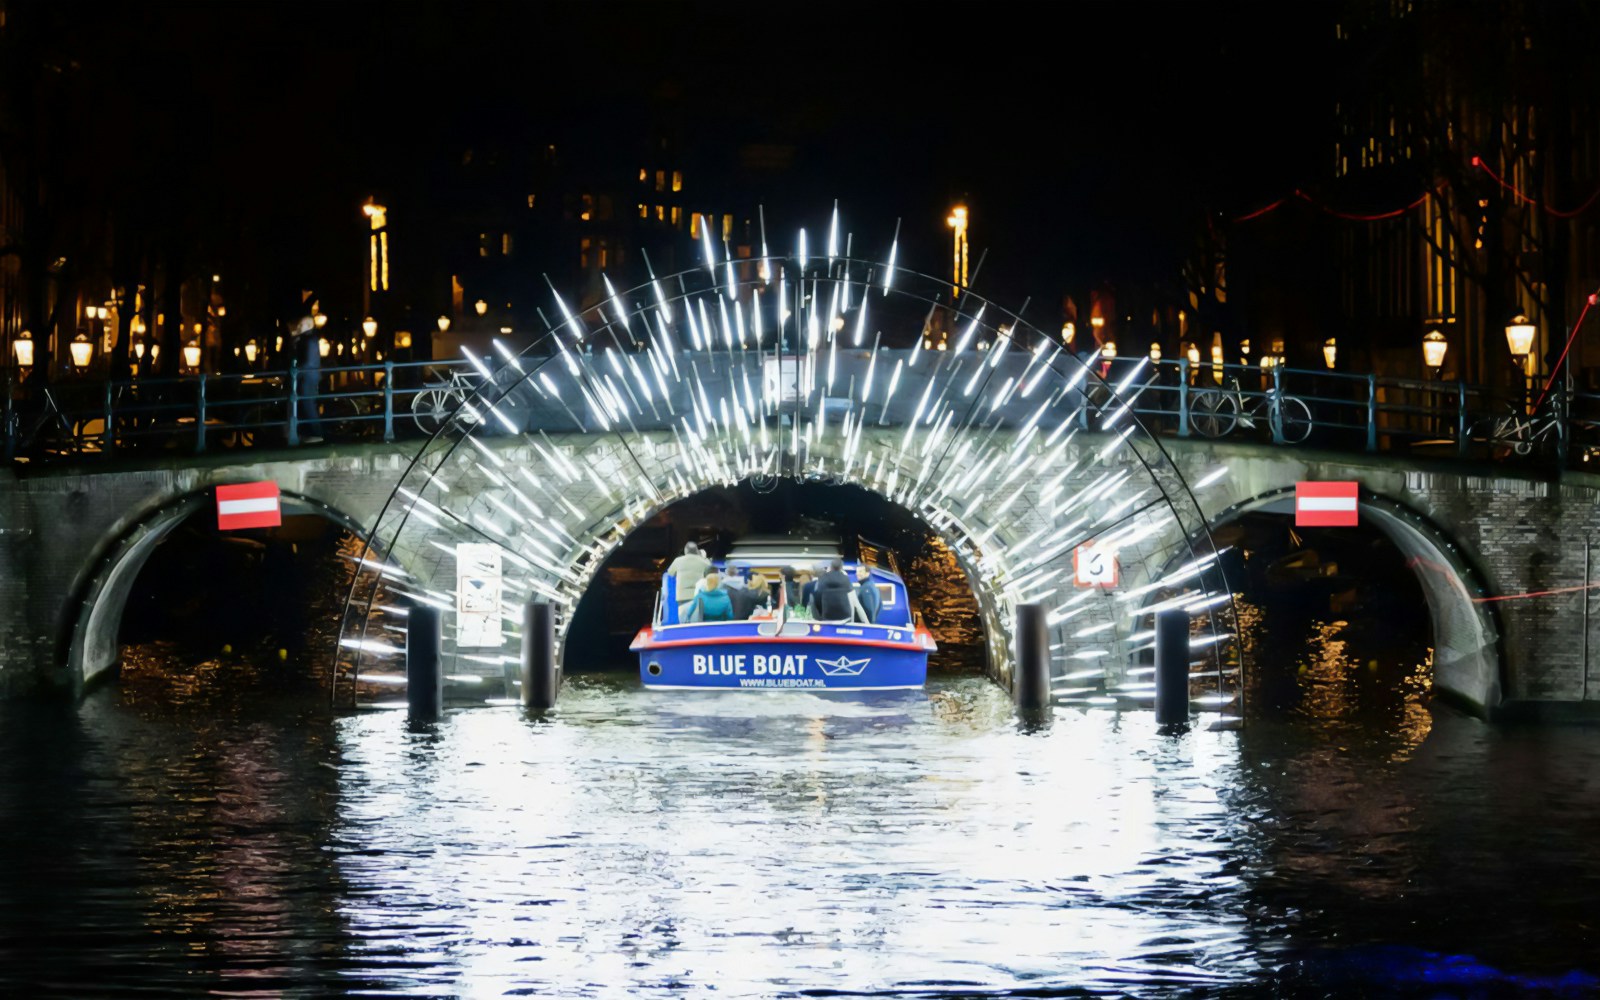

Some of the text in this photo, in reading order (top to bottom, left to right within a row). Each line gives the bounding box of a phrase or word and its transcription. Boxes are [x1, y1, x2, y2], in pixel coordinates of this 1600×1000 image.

[693, 655, 808, 675] BLUE BOAT
[740, 678, 826, 688] WWW.BLUEBOAT.NL
